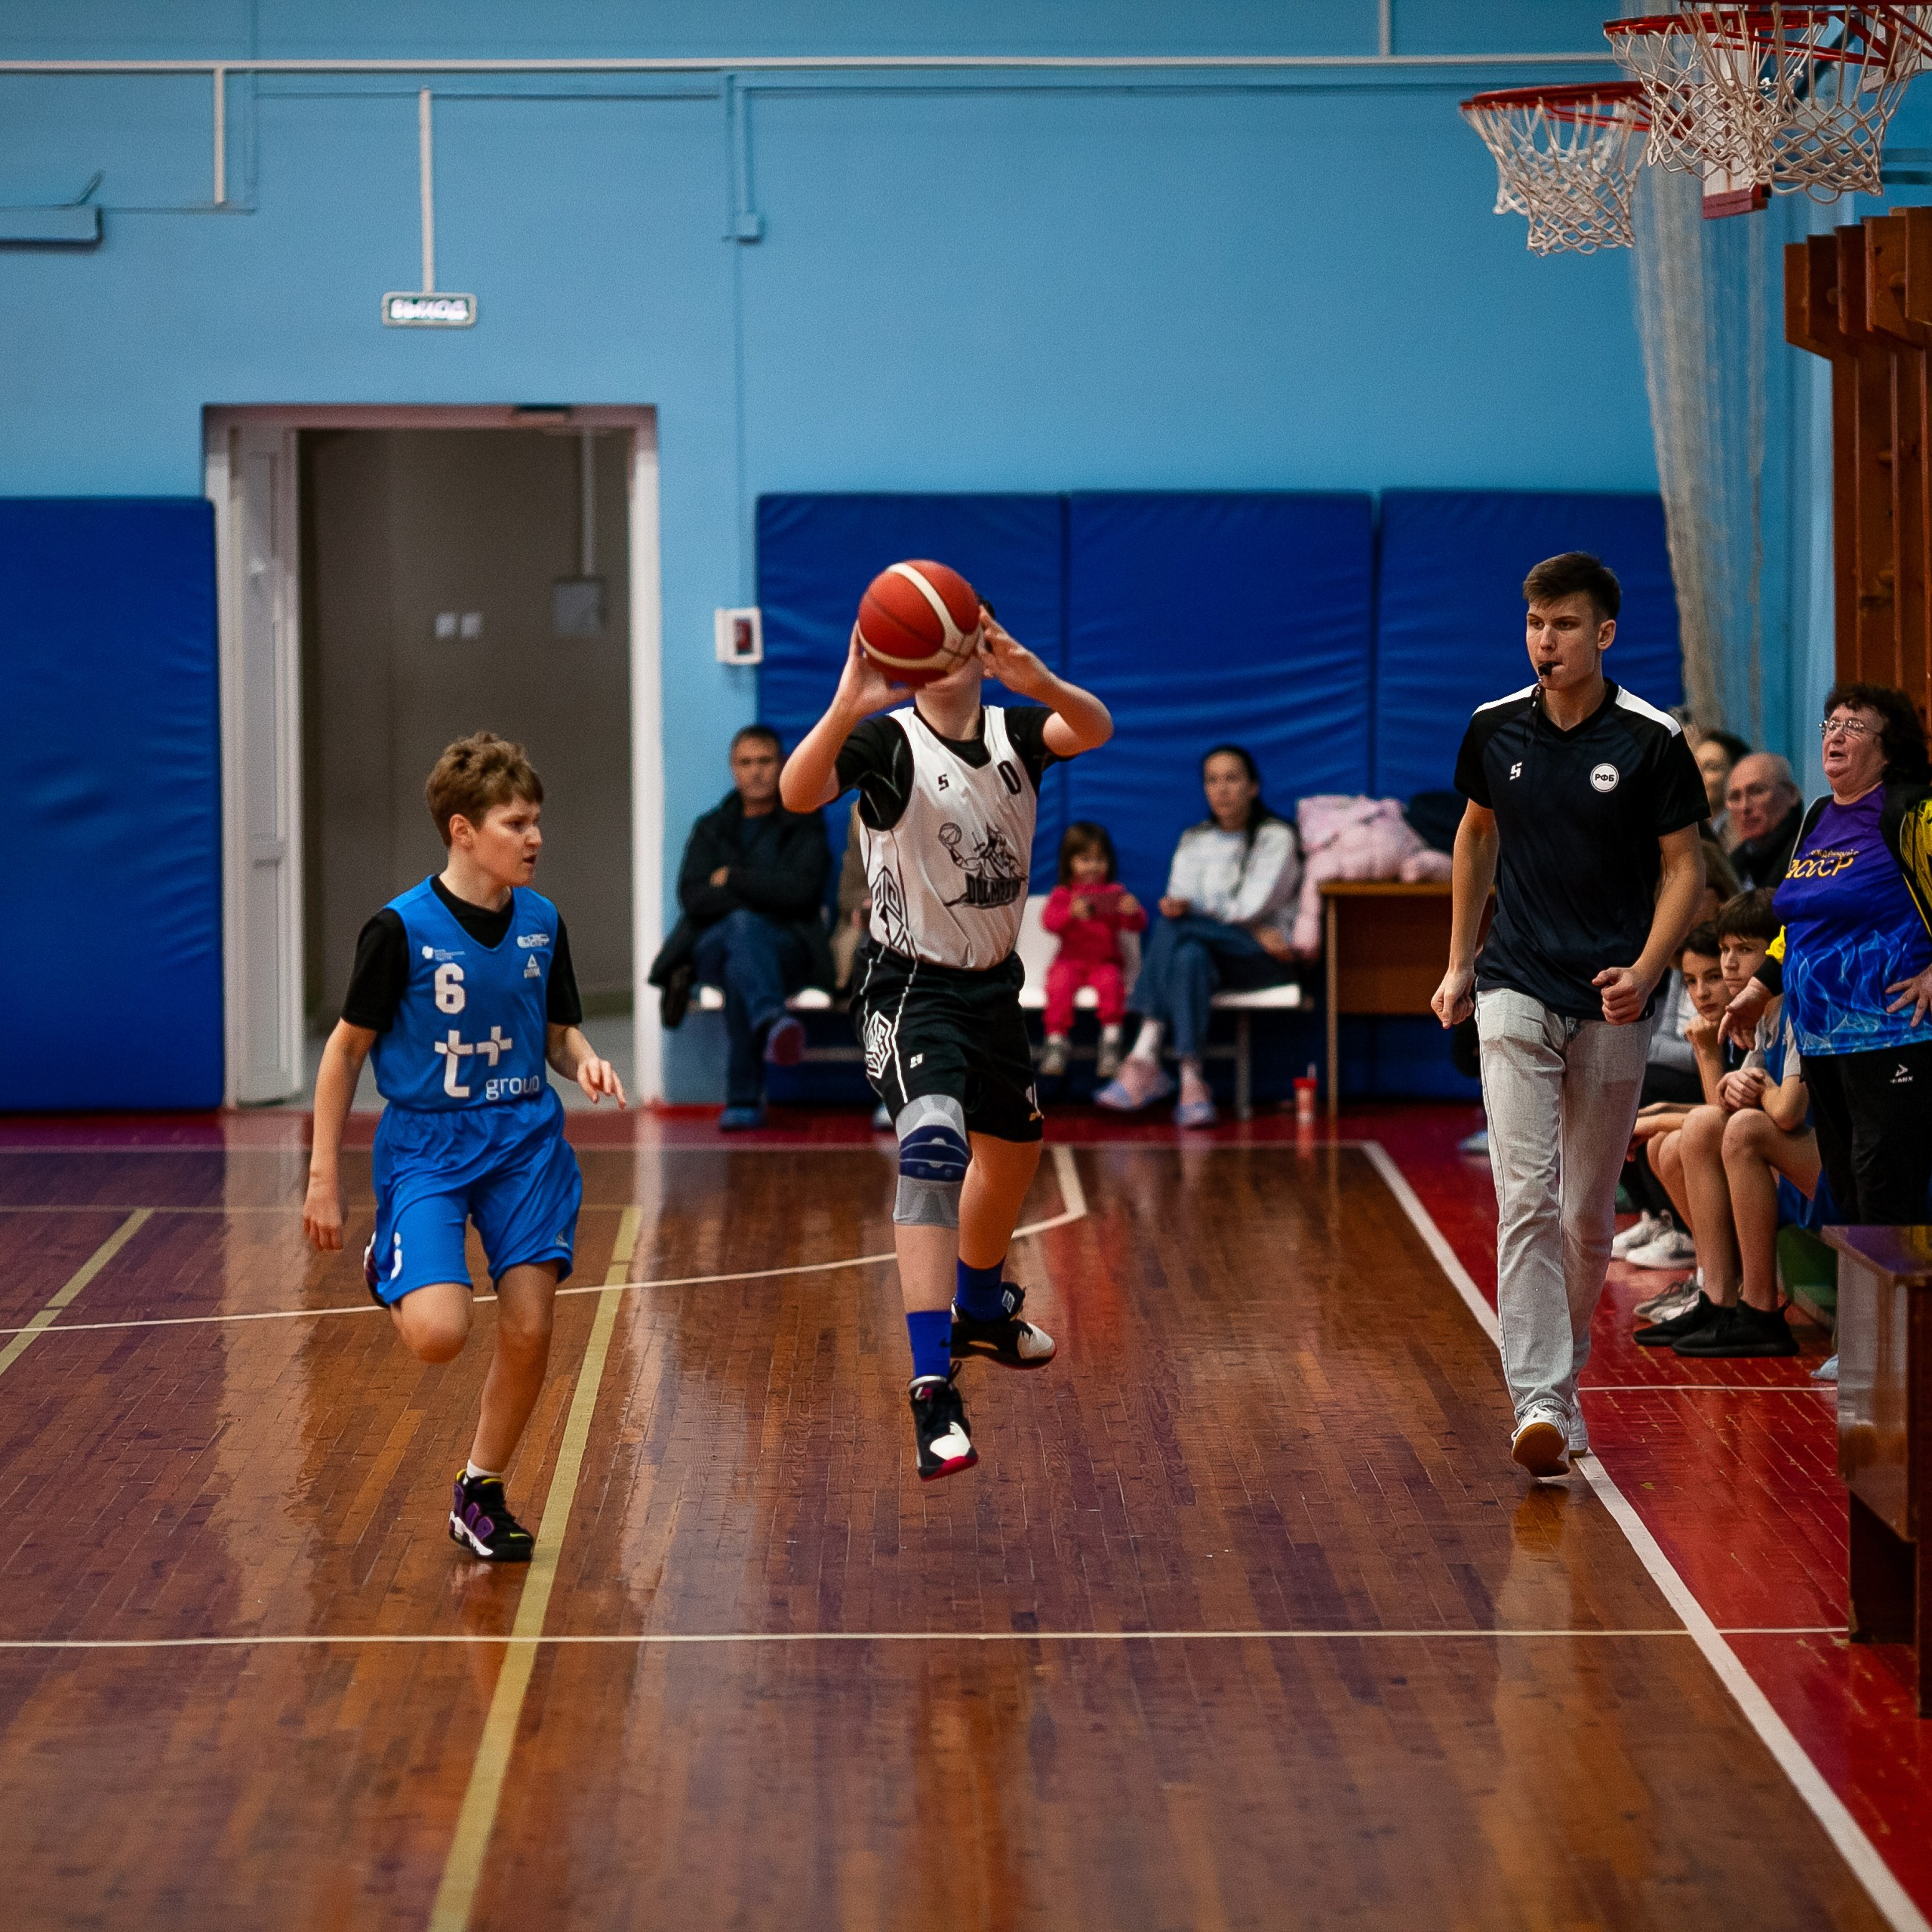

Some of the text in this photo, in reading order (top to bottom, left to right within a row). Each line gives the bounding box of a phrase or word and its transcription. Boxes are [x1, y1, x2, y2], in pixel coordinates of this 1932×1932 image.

[1595, 774, 1614, 782] РФБ
[434, 962, 466, 1014] 6
[485, 1075, 540, 1100] group
